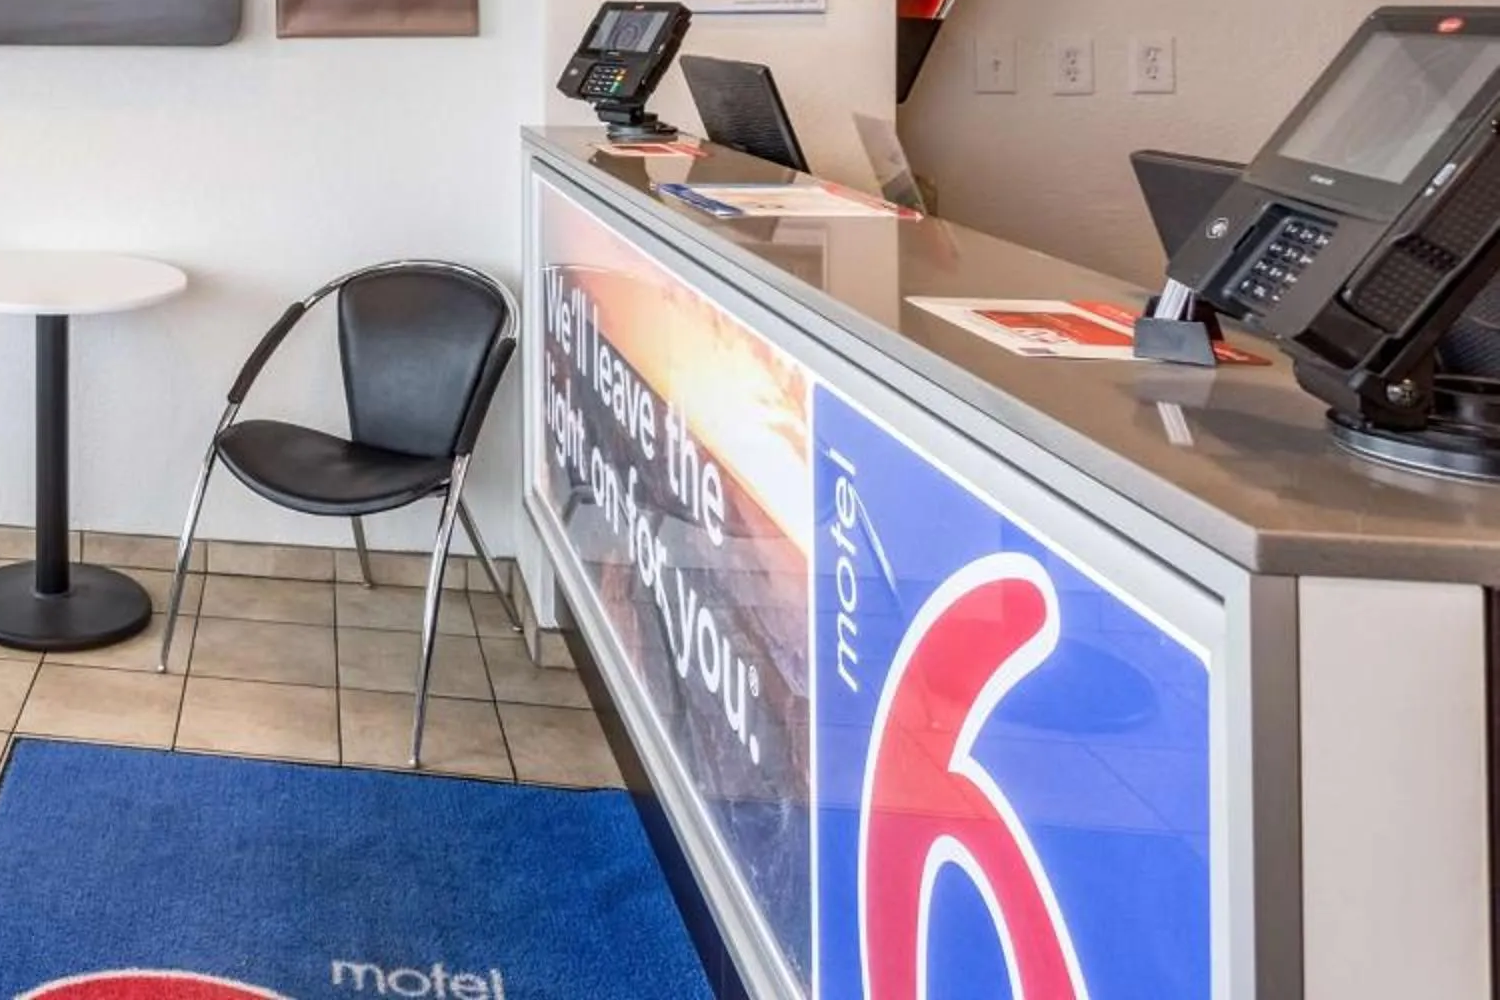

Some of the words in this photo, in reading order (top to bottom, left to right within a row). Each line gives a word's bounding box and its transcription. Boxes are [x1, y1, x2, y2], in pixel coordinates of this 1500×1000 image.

[545, 263, 587, 377] We'll
[592, 304, 656, 460] leave
[664, 397, 725, 547] the
[546, 349, 588, 482] light
[591, 446, 620, 536] on
[626, 465, 668, 606] for
[828, 447, 858, 692] motel
[857, 550, 1091, 1000] 6
[331, 959, 505, 1000] motel
